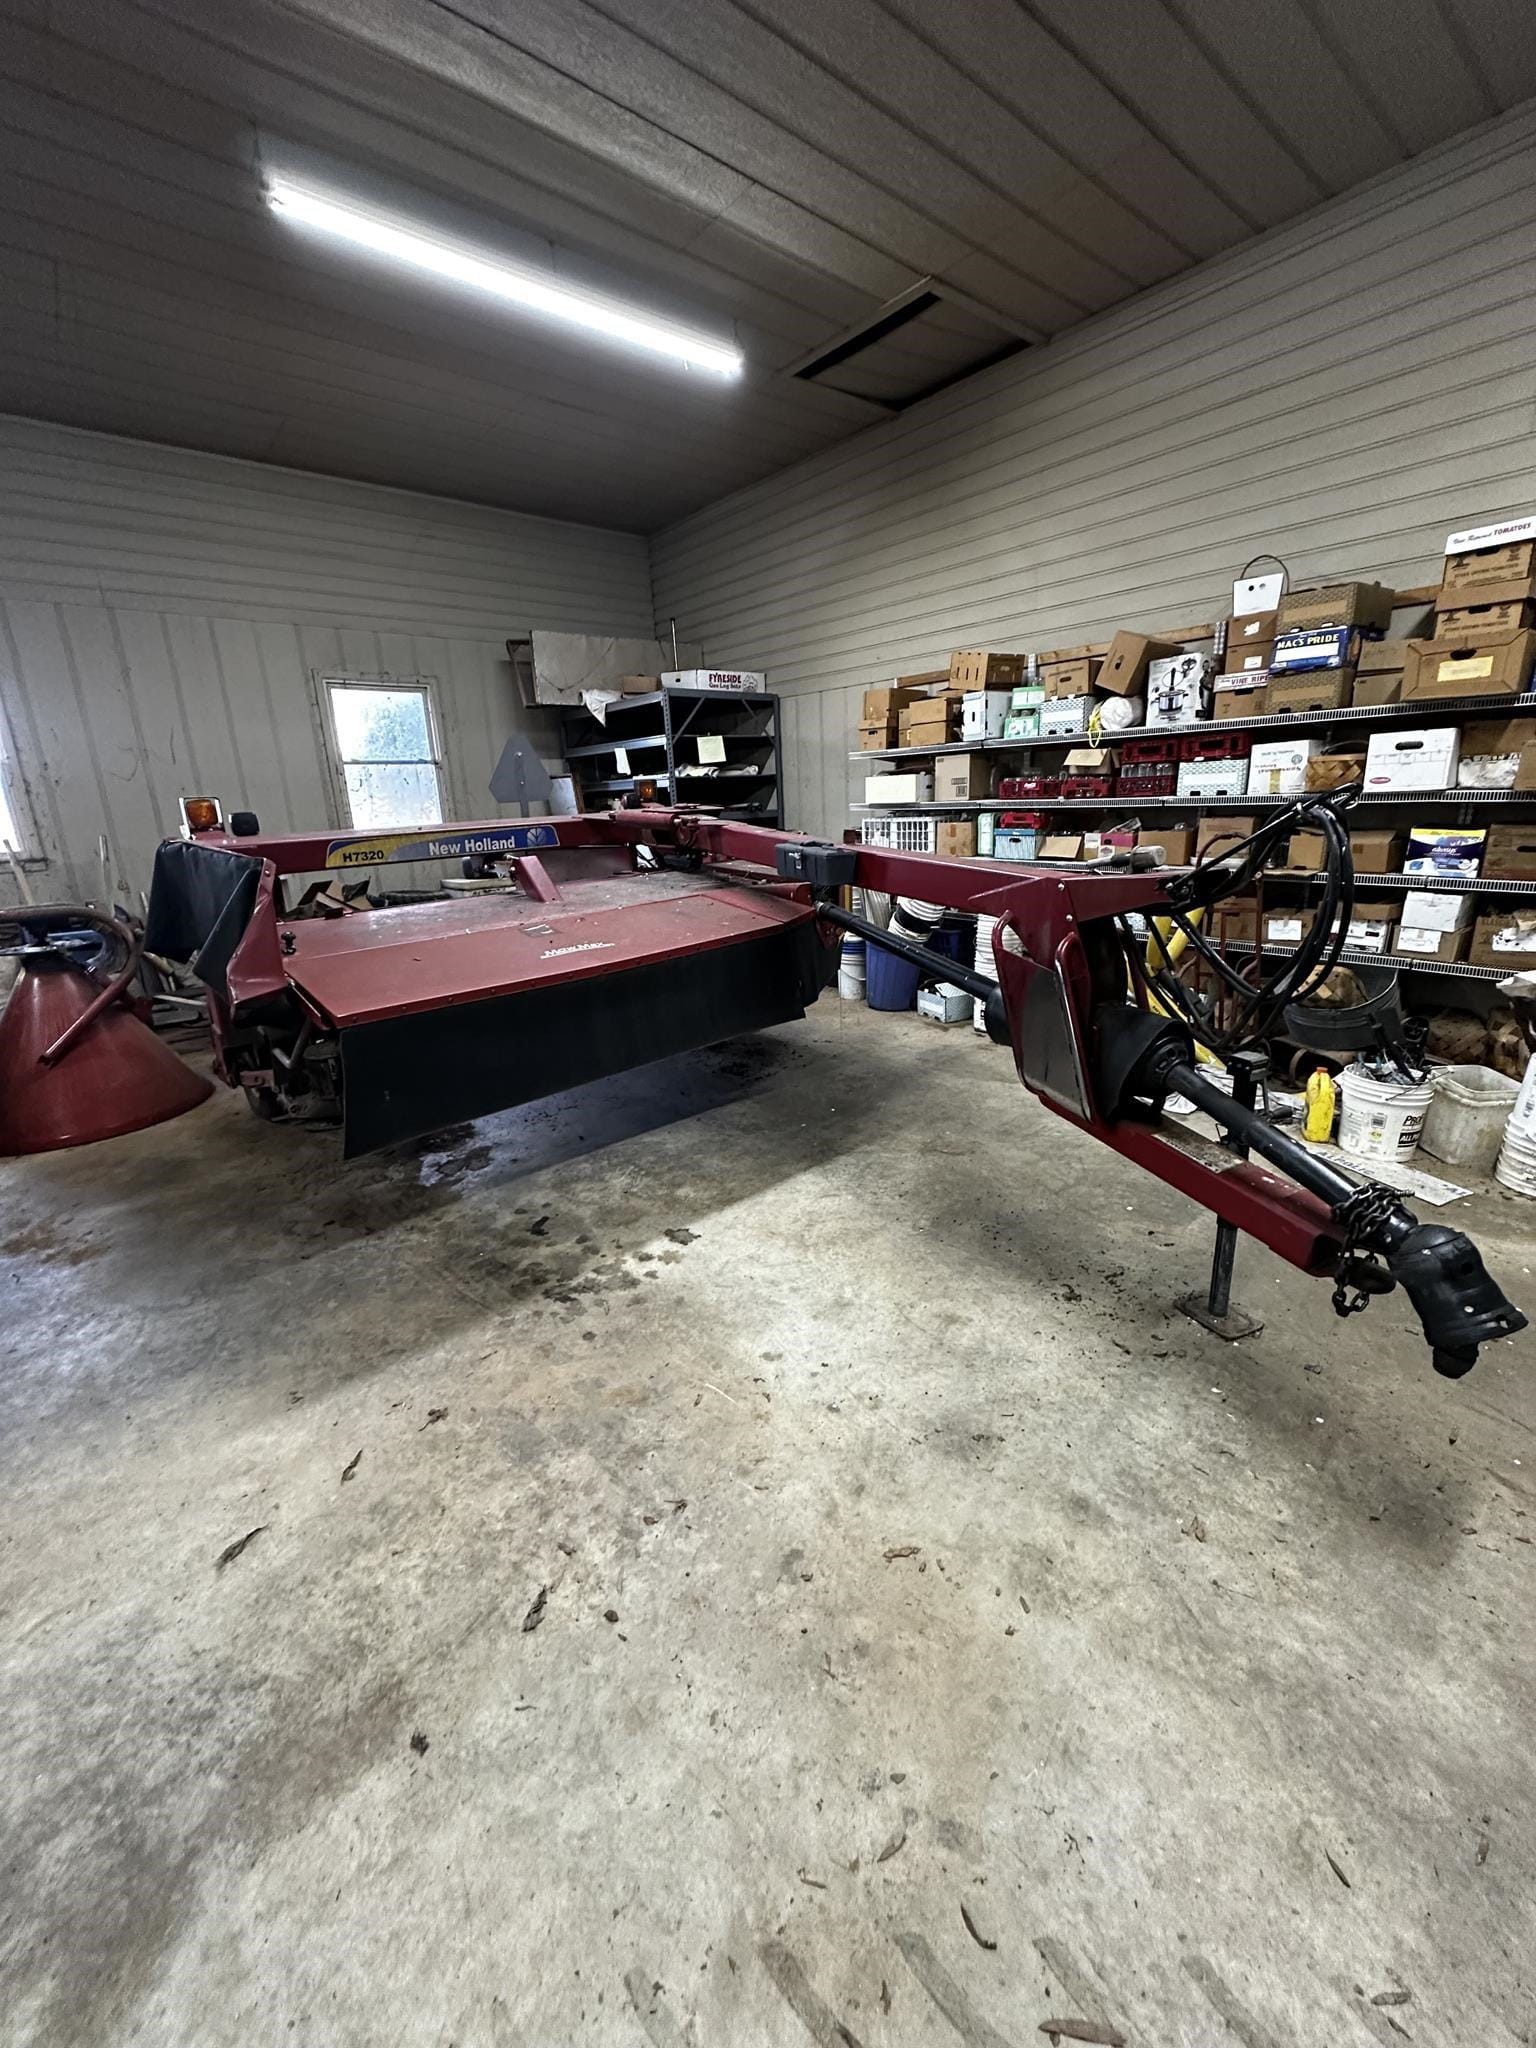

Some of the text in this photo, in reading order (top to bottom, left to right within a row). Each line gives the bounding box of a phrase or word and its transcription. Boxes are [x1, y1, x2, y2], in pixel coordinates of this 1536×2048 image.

[1494, 522, 1531, 536] TOMATOES
[1307, 634, 1340, 645] PRIDE
[709, 673, 742, 684] FYRESIDE
[1231, 678, 1249, 686] VINE
[342, 836, 516, 863] H7320 New Holland
